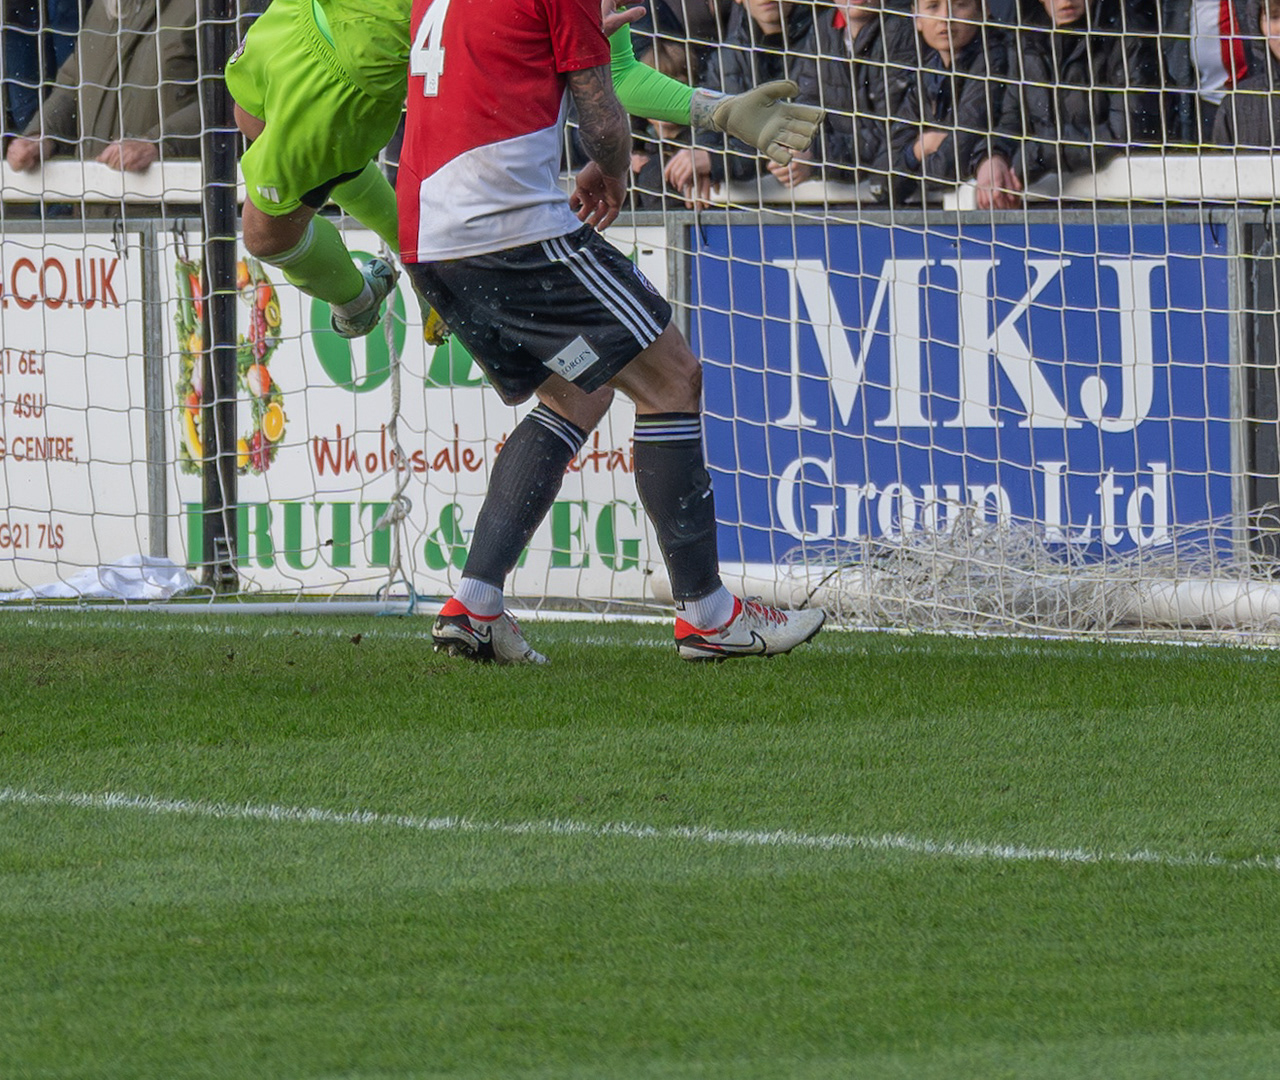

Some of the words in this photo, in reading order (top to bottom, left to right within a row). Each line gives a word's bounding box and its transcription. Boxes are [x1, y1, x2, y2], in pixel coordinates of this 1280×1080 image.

[772, 258, 1168, 433] MKJ
[12, 392, 44, 419] 4SU
[11, 436, 79, 466] CENTRE,
[312, 422, 483, 477] Wholesale
[564, 430, 634, 474] etai
[1036, 461, 1174, 548] Ltd
[37, 524, 65, 550] 7LS
[423, 502, 477, 571] &
[516, 498, 643, 572] EG
